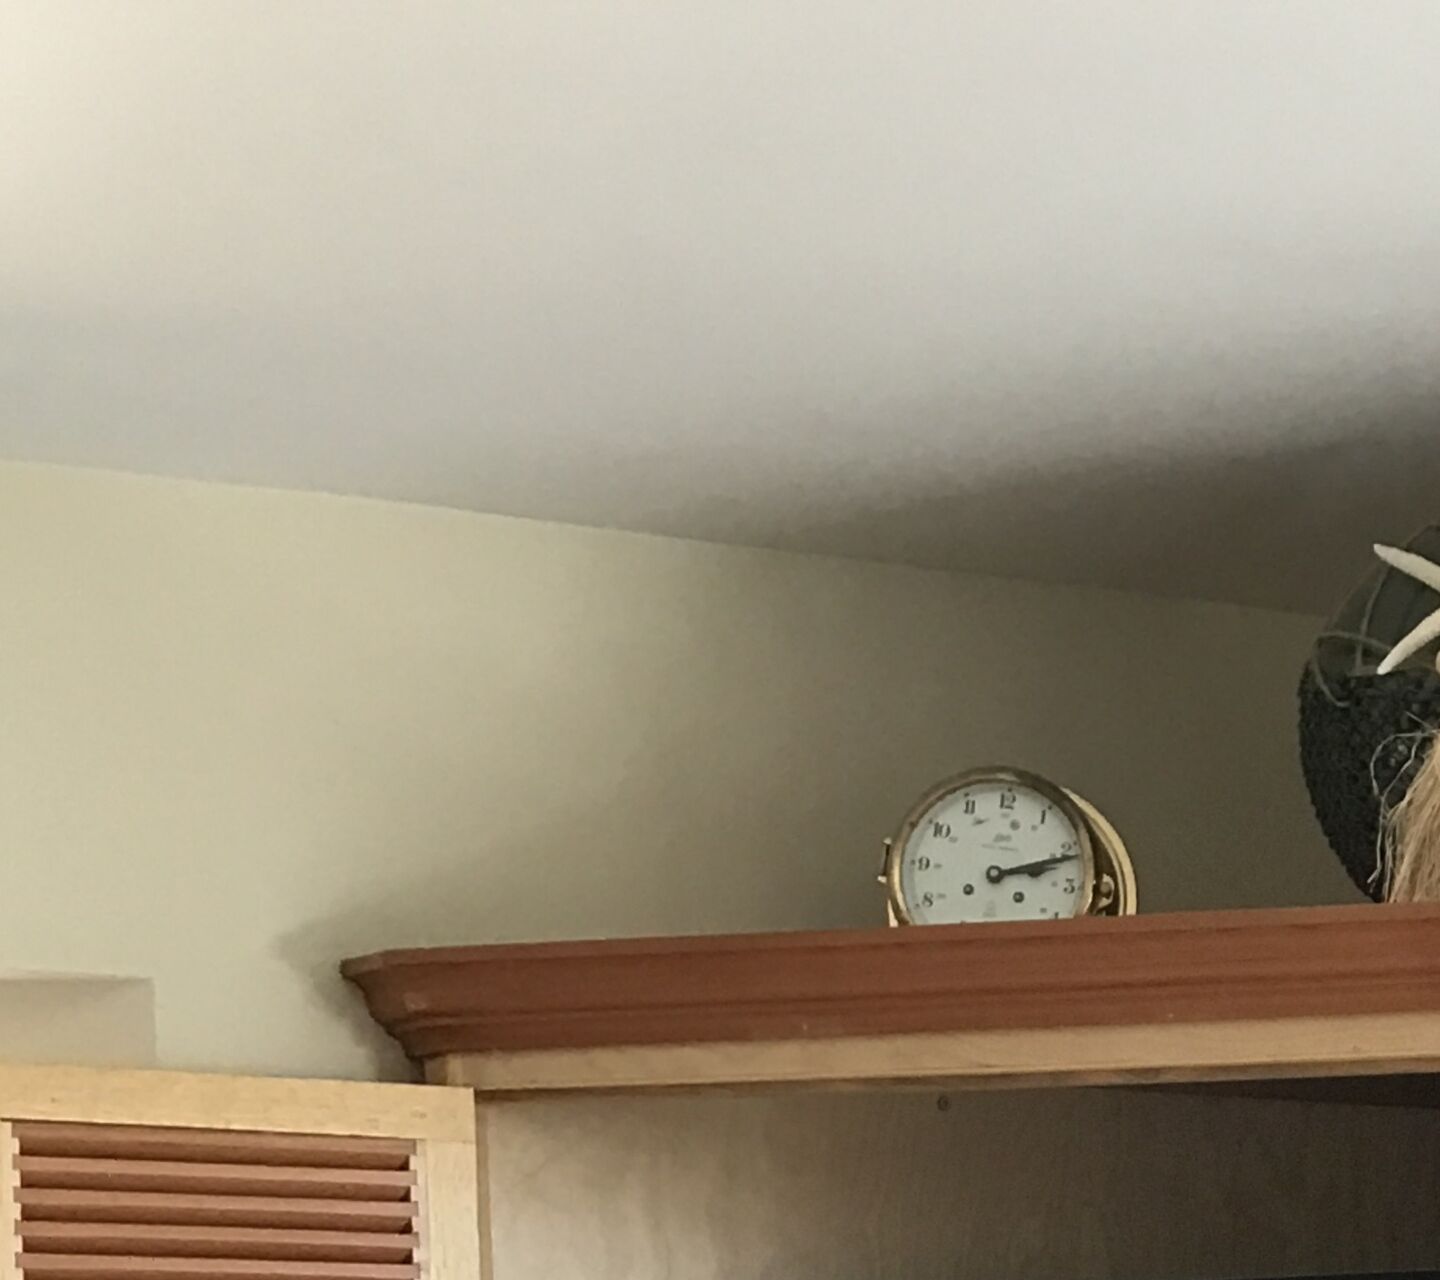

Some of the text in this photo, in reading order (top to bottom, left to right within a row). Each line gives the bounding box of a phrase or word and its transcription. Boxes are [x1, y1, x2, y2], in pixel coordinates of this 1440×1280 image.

[964, 799, 976, 815] 11
[1000, 793, 1016, 810] 12
[1039, 809, 1046, 824] 1
[932, 822, 950, 838] 10
[1061, 842, 1072, 853] 2
[918, 856, 930, 871] 9
[1063, 877, 1075, 894] 3
[921, 892, 933, 907] 8
